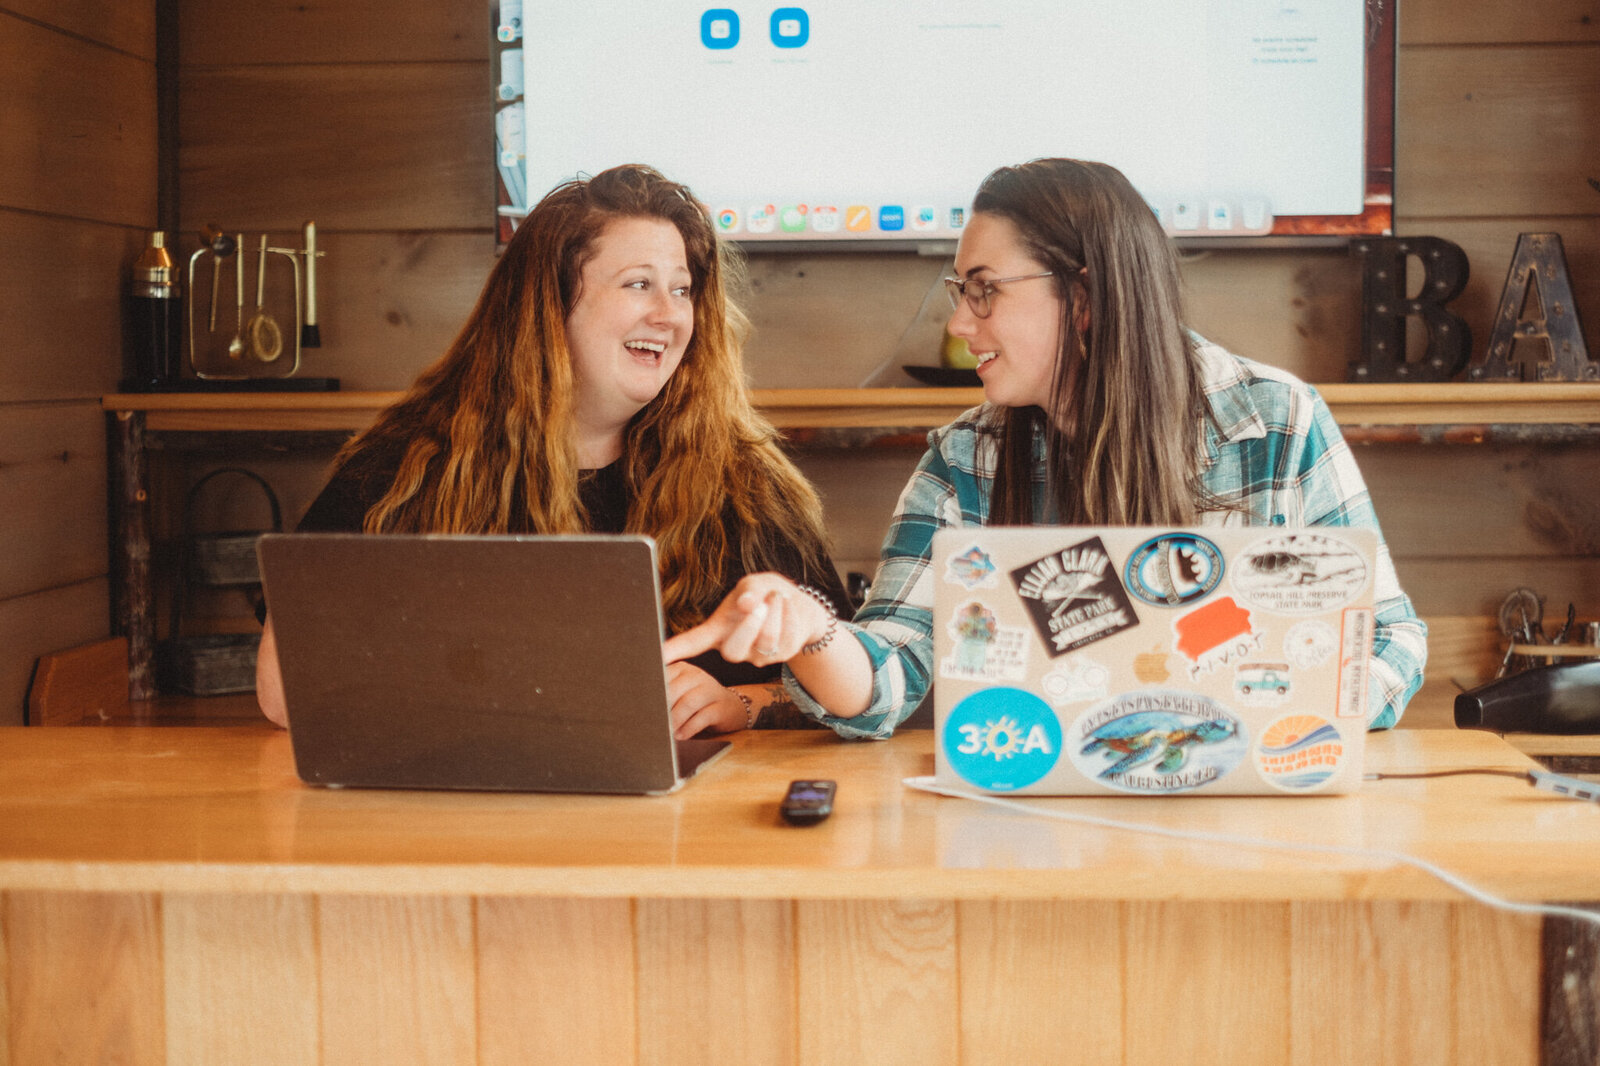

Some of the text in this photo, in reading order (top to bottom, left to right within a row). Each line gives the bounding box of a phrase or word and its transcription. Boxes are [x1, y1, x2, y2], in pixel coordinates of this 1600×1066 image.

[1275, 600, 1323, 609] STATE PARK
[1306, 590, 1348, 600] PRESERVE
[1048, 607, 1085, 634] STATE
[1083, 595, 1117, 620] PARK
[957, 715, 1052, 761] 30A
